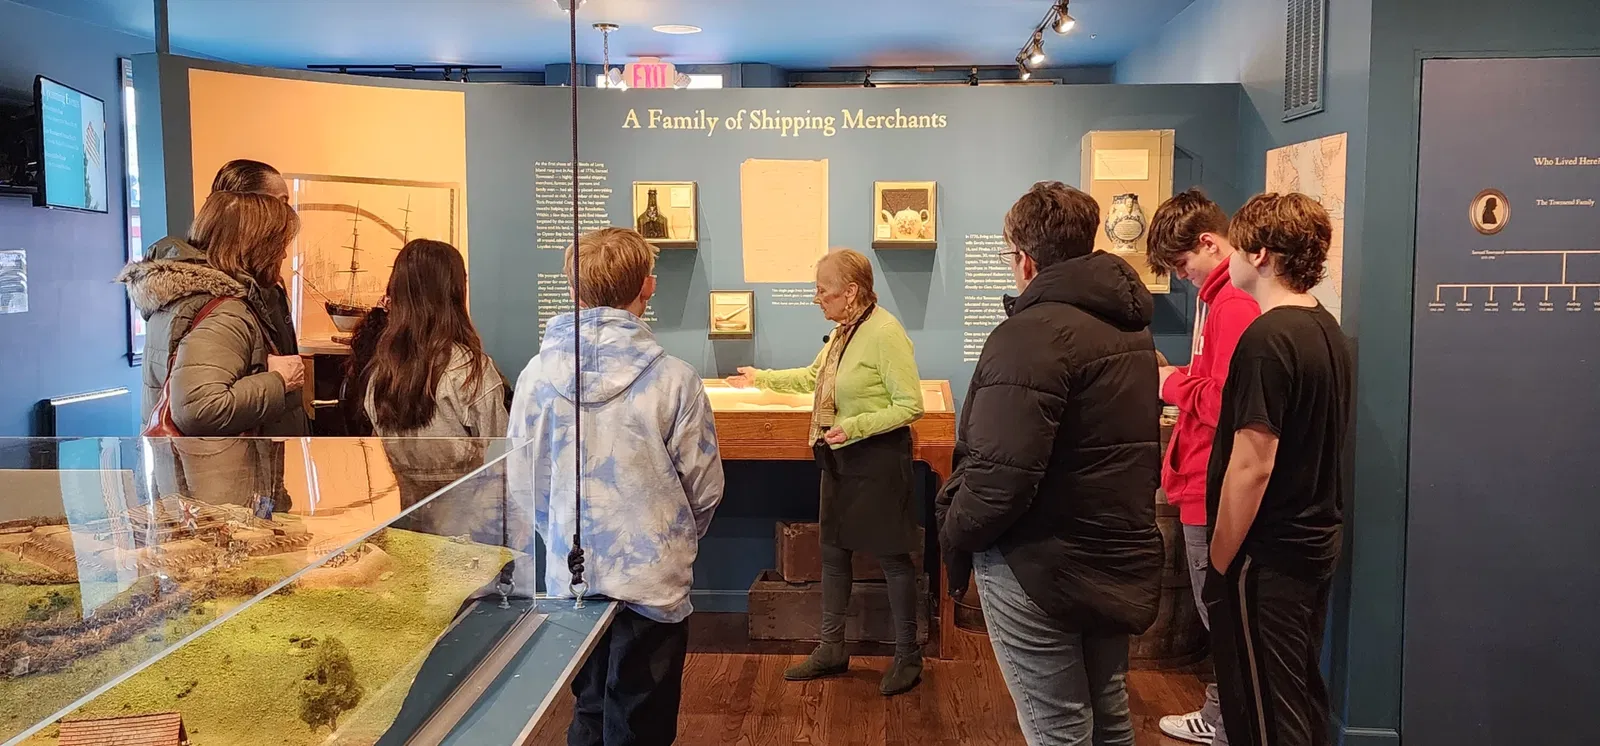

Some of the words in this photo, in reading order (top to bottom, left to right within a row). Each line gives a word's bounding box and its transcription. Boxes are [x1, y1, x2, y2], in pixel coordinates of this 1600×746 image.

[634, 64, 667, 88] EXIT
[622, 109, 640, 130] A
[648, 108, 720, 137] Family
[725, 109, 746, 130] of
[749, 110, 836, 137] Shipping
[841, 108, 948, 130] Merchants
[1534, 157, 1553, 166] Who
[1555, 157, 1577, 166] Lived
[1576, 199, 1595, 207] Family
